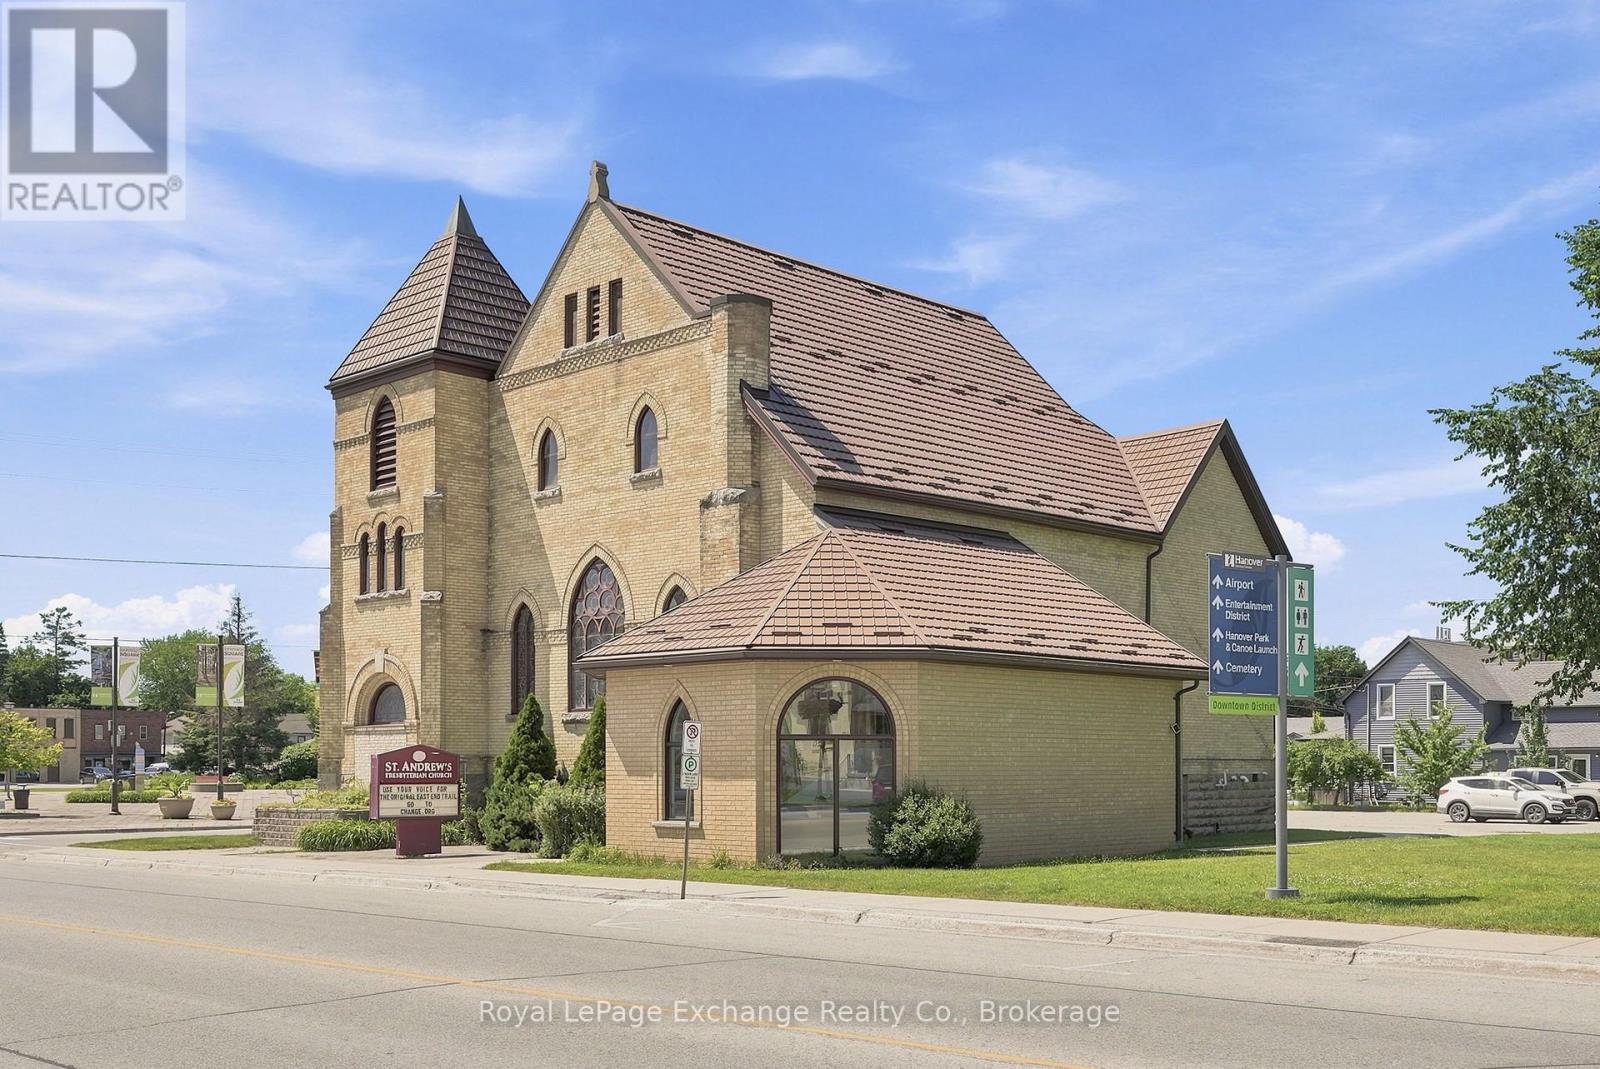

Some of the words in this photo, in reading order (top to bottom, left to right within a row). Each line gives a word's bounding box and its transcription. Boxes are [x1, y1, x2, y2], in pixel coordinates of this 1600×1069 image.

[1235, 554, 1264, 567] Hanover
[1226, 577, 1254, 591] Airport
[1225, 599, 1273, 612] Entertainment
[1225, 611, 1251, 622] District
[1225, 630, 1254, 642] Hanover
[1254, 632, 1270, 643] Park
[1225, 643, 1231, 652] &
[1231, 643, 1253, 653] Canoe
[1253, 645, 1278, 656] Launch
[1225, 662, 1263, 677] Cemetery
[1212, 700, 1250, 712] Downtown
[1251, 702, 1277, 712] District
[385, 761, 400, 772] ST.
[401, 761, 452, 772] ANDREW'S
